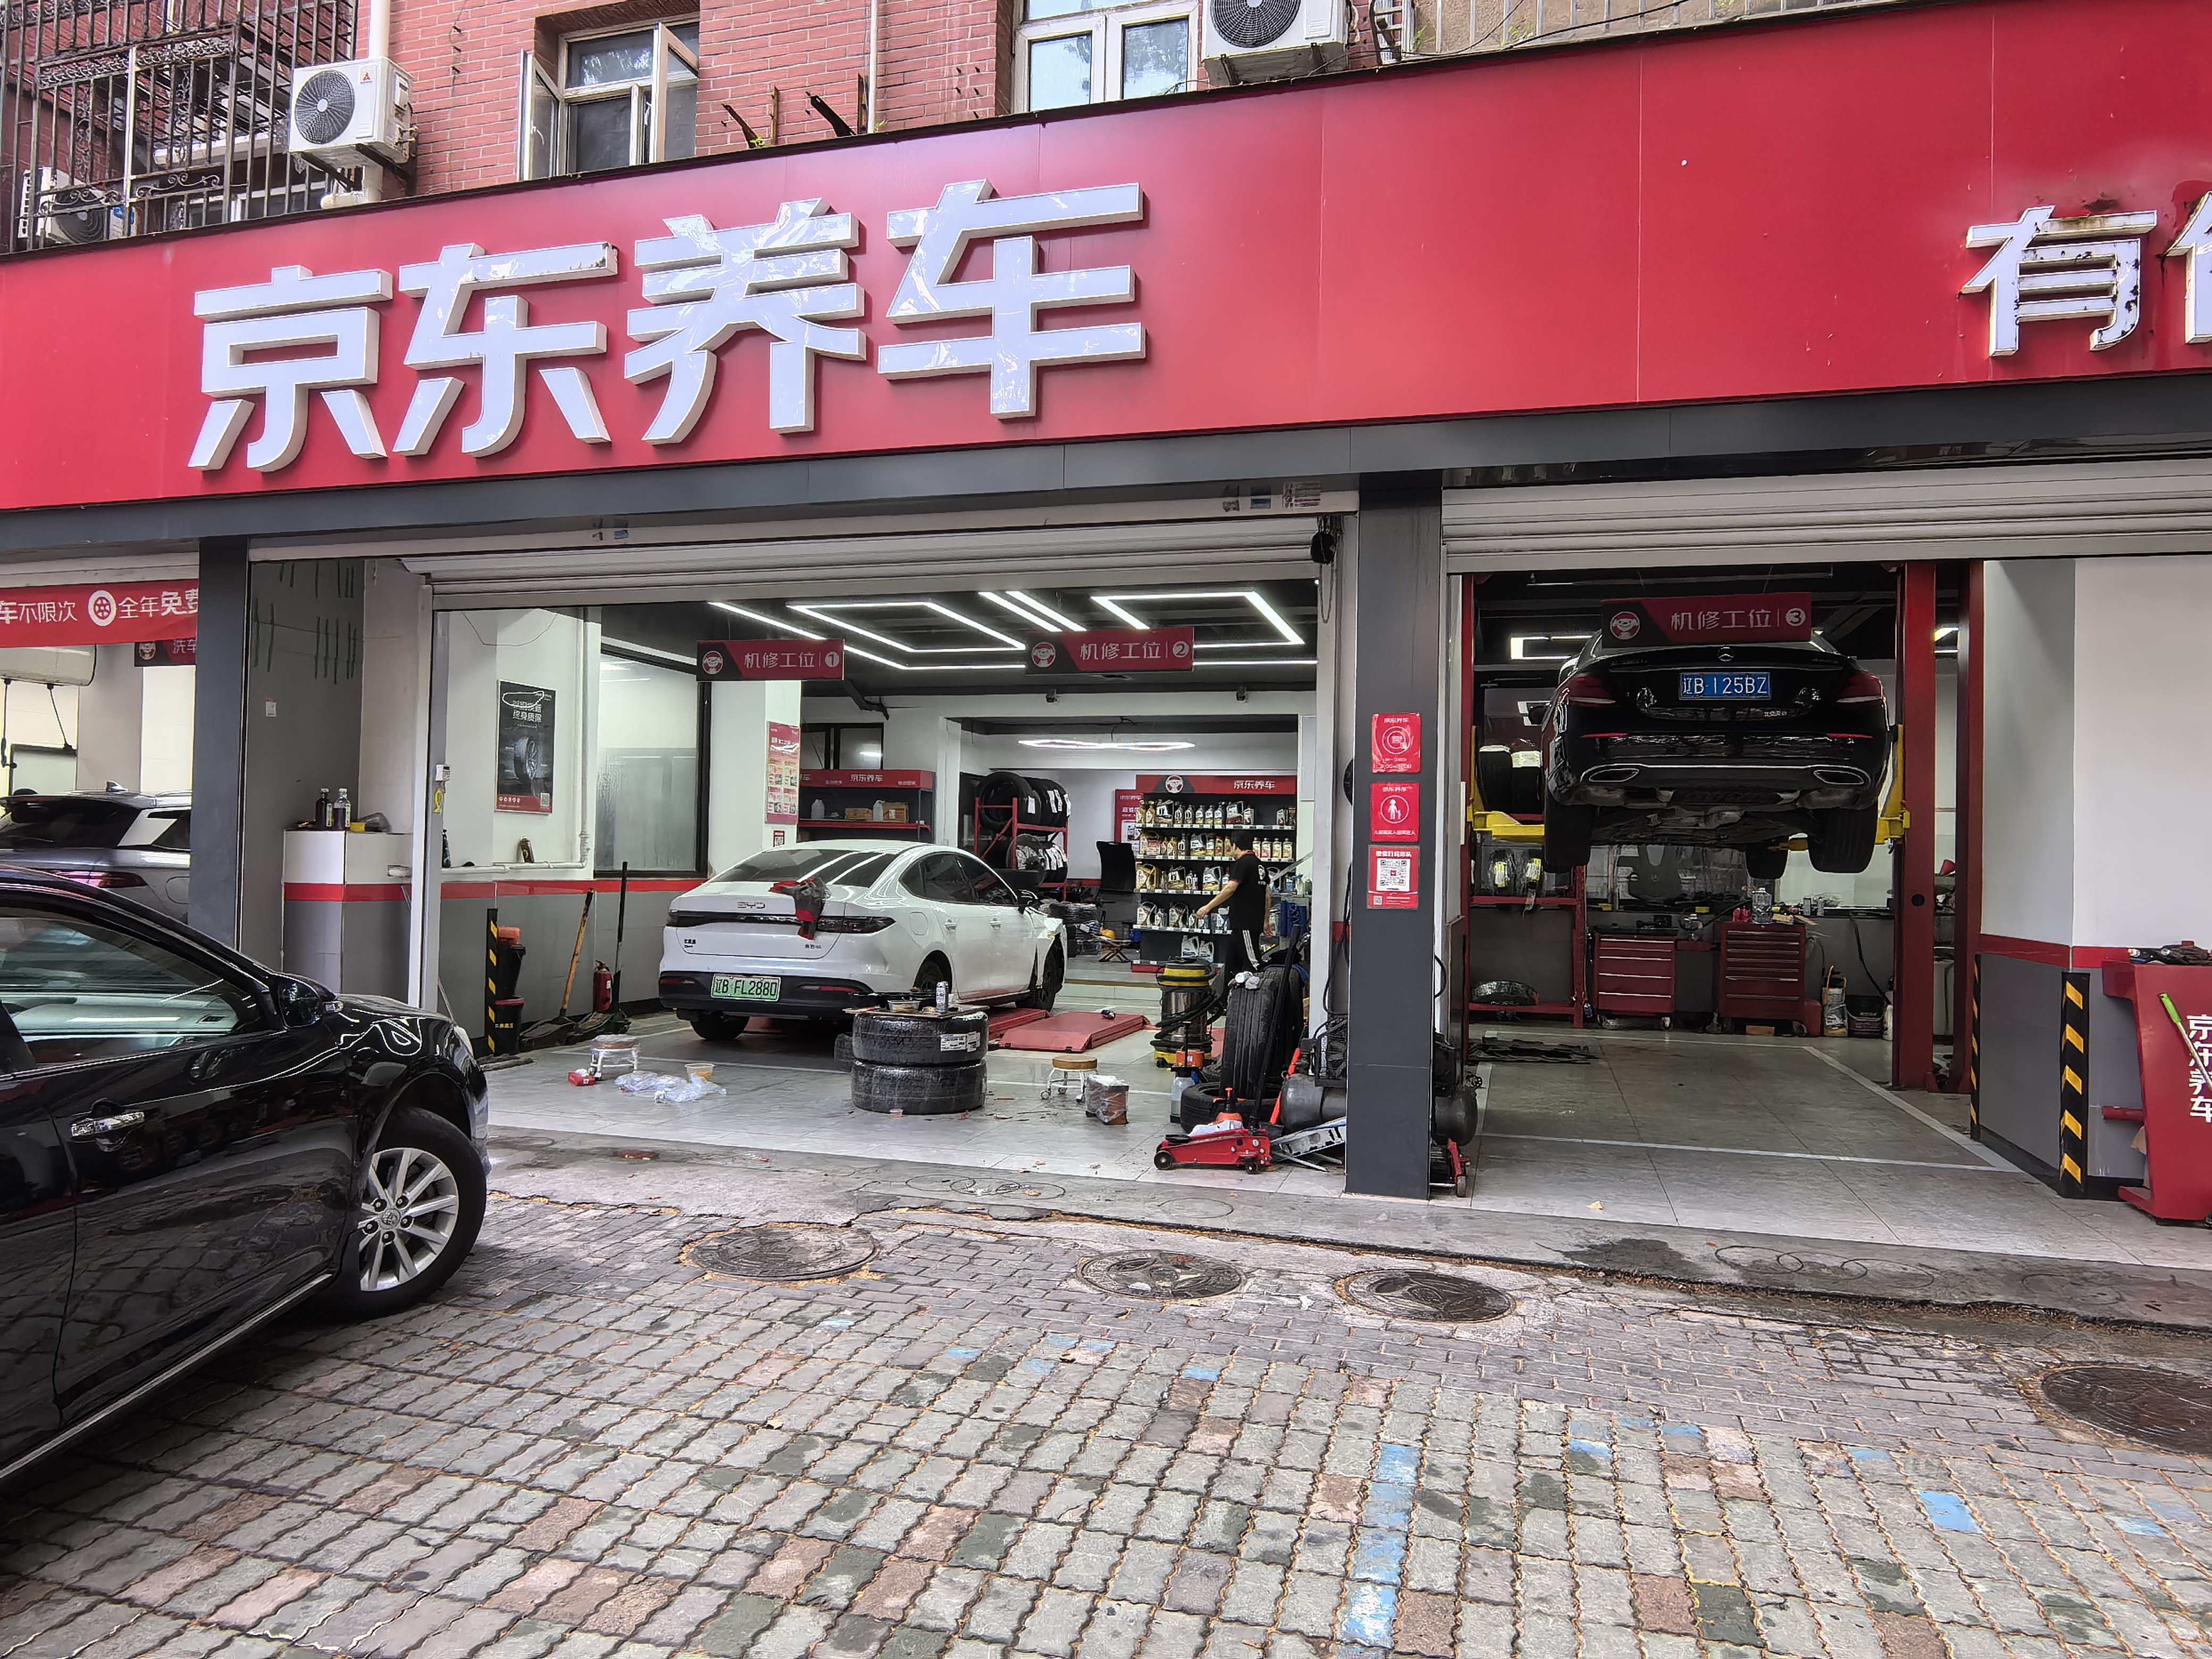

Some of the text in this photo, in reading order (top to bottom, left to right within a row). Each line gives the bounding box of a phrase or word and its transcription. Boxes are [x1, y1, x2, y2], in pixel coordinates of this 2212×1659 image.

[187, 179, 1146, 473] 京东养车
[1671, 609, 1772, 631] 机修工位
[744, 652, 815, 668] 机修工位
[1080, 641, 1161, 660] 机修工位
[1233, 780, 1276, 790] 京东养车
